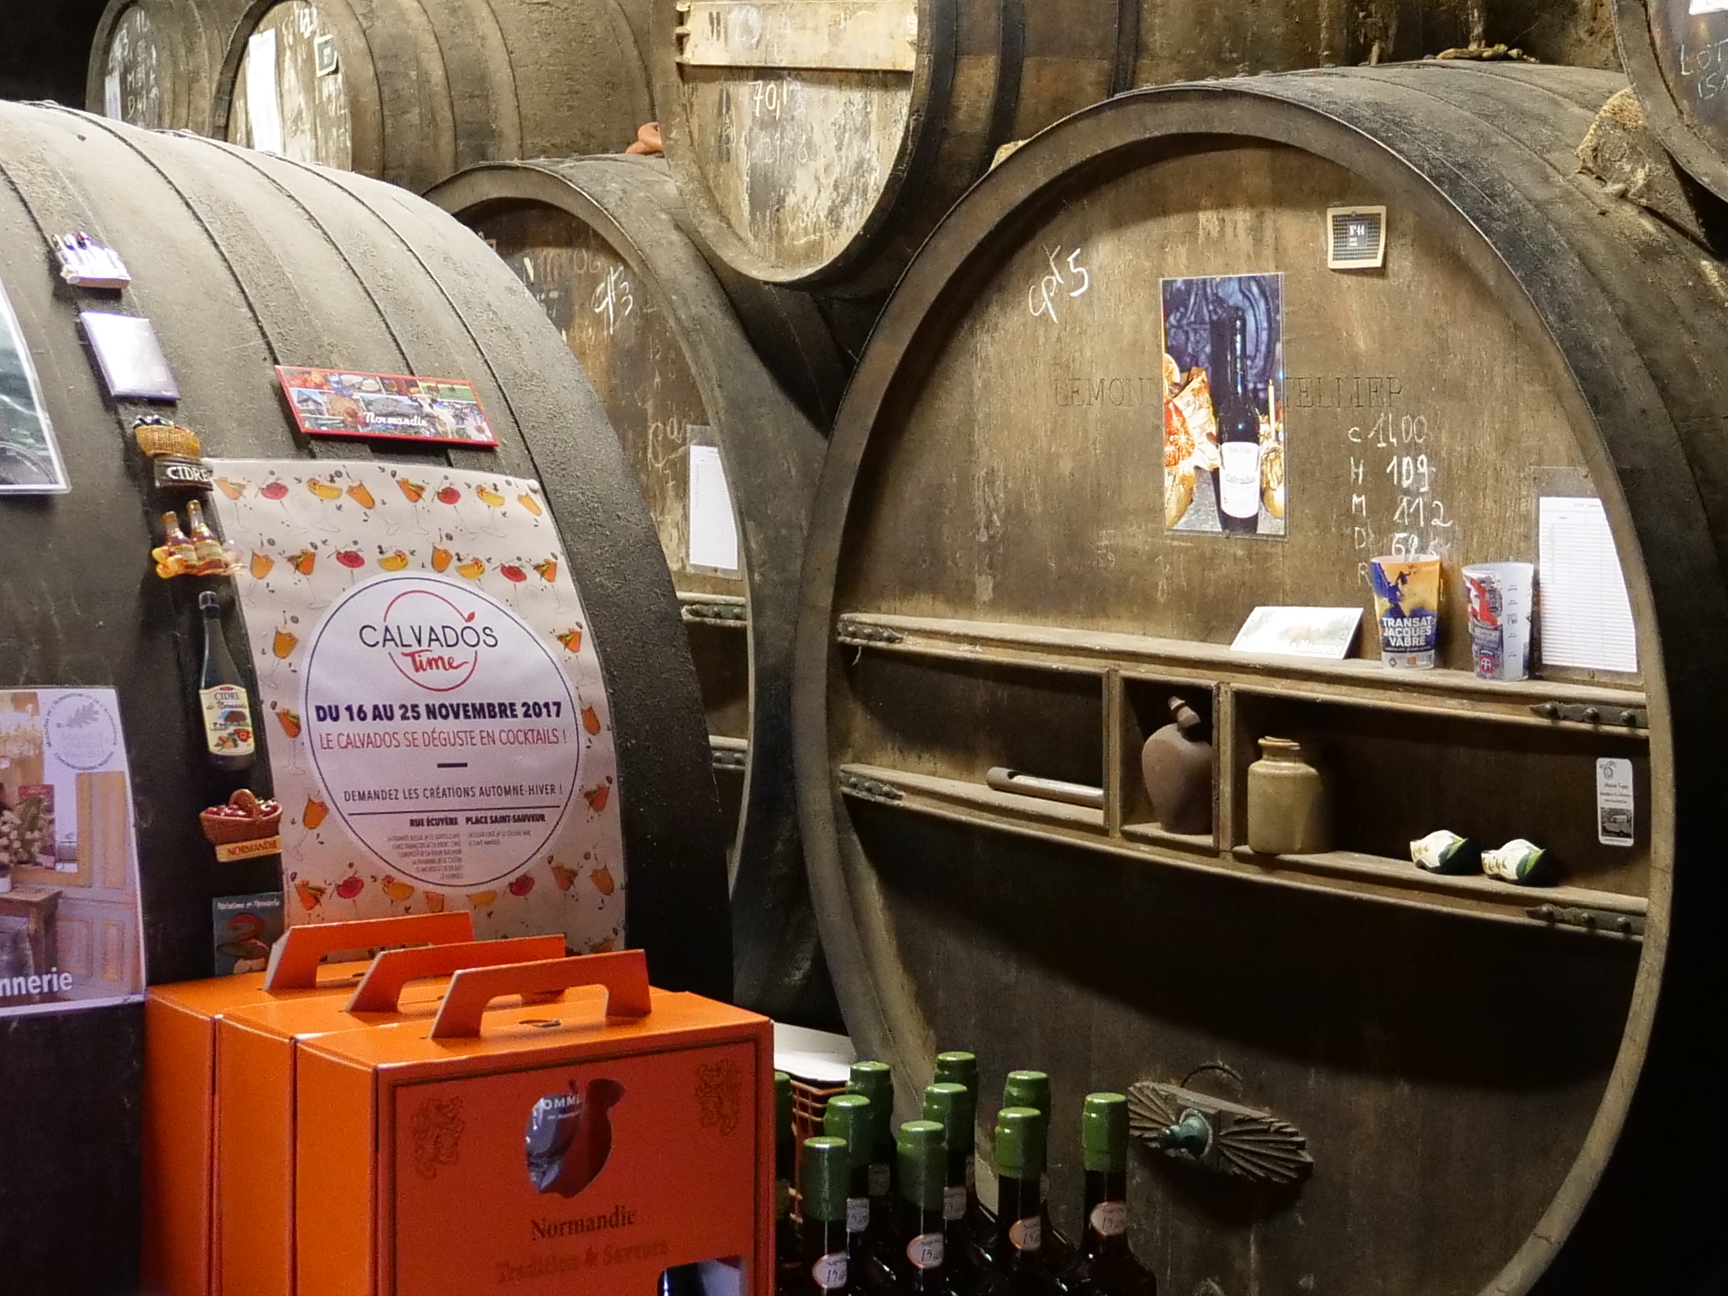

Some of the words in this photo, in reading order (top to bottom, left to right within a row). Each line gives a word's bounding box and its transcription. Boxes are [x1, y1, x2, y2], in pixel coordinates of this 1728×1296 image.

[1067, 248, 1090, 297] 5
[362, 411, 428, 428] Normandie
[166, 465, 213, 483] CIDRE
[1352, 493, 1366, 516] M
[1381, 617, 1433, 629] TRANSAT
[1382, 627, 1432, 638] JACQUES
[359, 623, 499, 649] CALVADOS
[1388, 635, 1427, 647] VABRE
[402, 648, 470, 673] Time
[315, 704, 341, 722] DU
[344, 703, 368, 722] 16
[372, 703, 395, 721] AU
[399, 702, 422, 720] 25
[426, 702, 519, 720] NOVEMBRE
[521, 701, 562, 719] 2017
[319, 732, 332, 750] LE
[336, 730, 402, 749] CALVADOS
[405, 730, 420, 748] SE
[422, 726, 478, 748] DÉGUSTE
[479, 729, 496, 746] EN
[498, 727, 560, 745] COCKTAILS
[343, 788, 400, 803] DEMANDEZ
[402, 786, 421, 801] LES
[422, 782, 477, 800] CRÉATIONS
[478, 782, 558, 798] AUTOMNE-HIVER
[465, 816, 488, 826] PLACE
[489, 813, 546, 825] SAINT-SAUVEUR
[227, 839, 279, 855] NORMANDIE
[530, 1204, 637, 1241] Normandie
